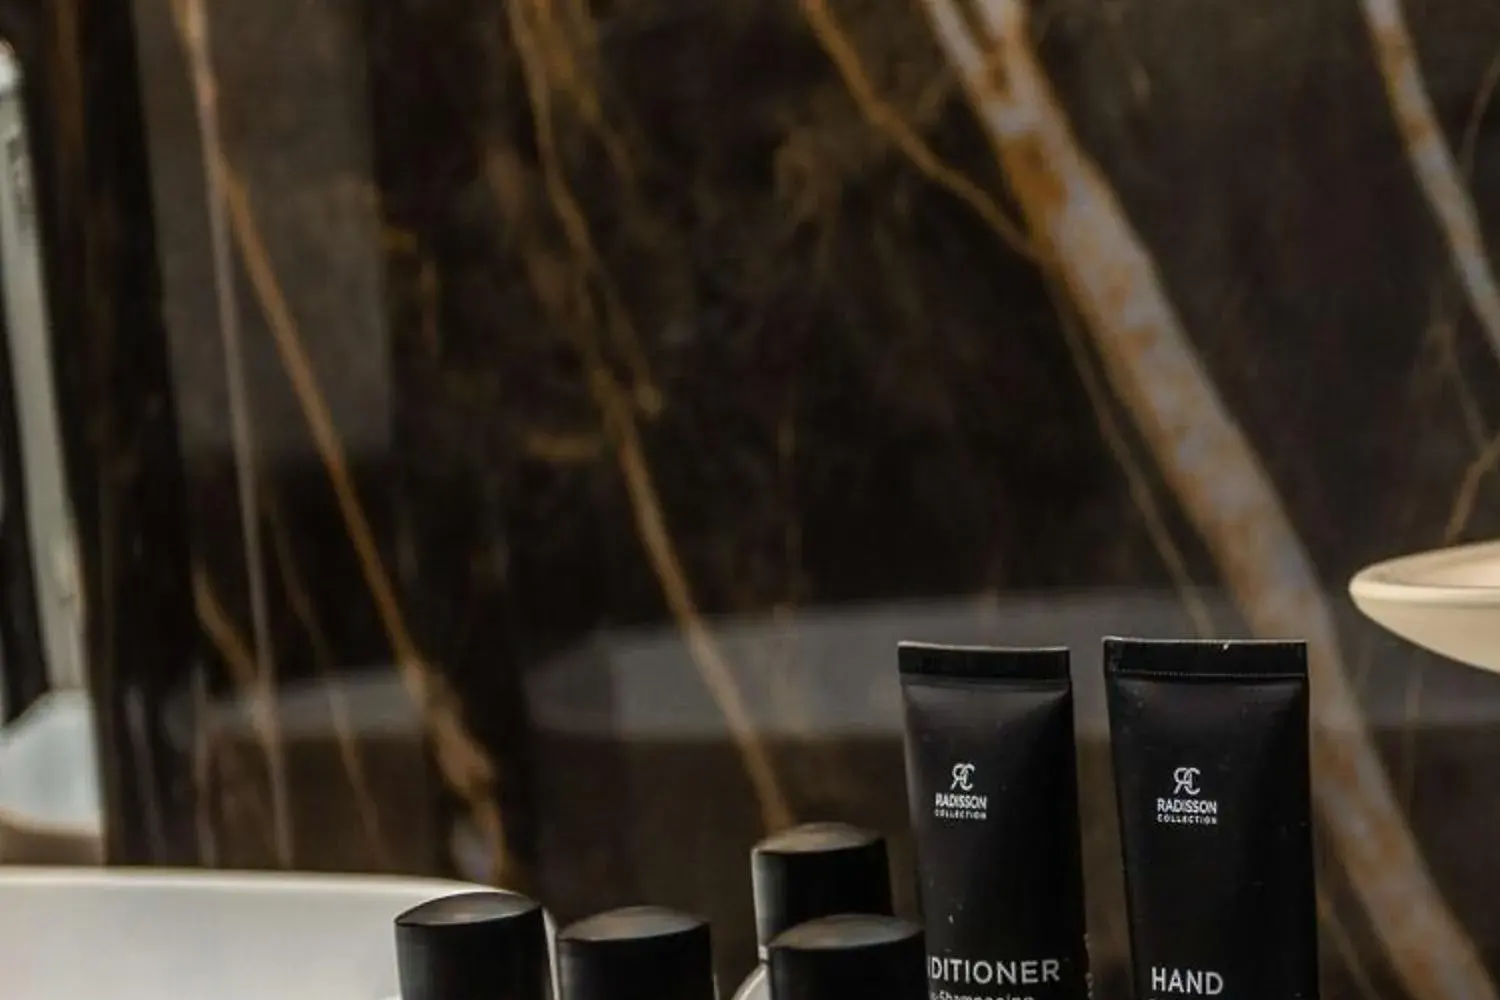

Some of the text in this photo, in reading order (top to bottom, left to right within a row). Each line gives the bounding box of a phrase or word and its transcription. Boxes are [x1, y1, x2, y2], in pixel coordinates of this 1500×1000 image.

[935, 792, 988, 810] RADISSON
[1156, 798, 1218, 815] RADISSON
[934, 809, 988, 820] COLLECTION
[1156, 814, 1218, 825] COLLECTION
[1151, 965, 1224, 996] HAND
